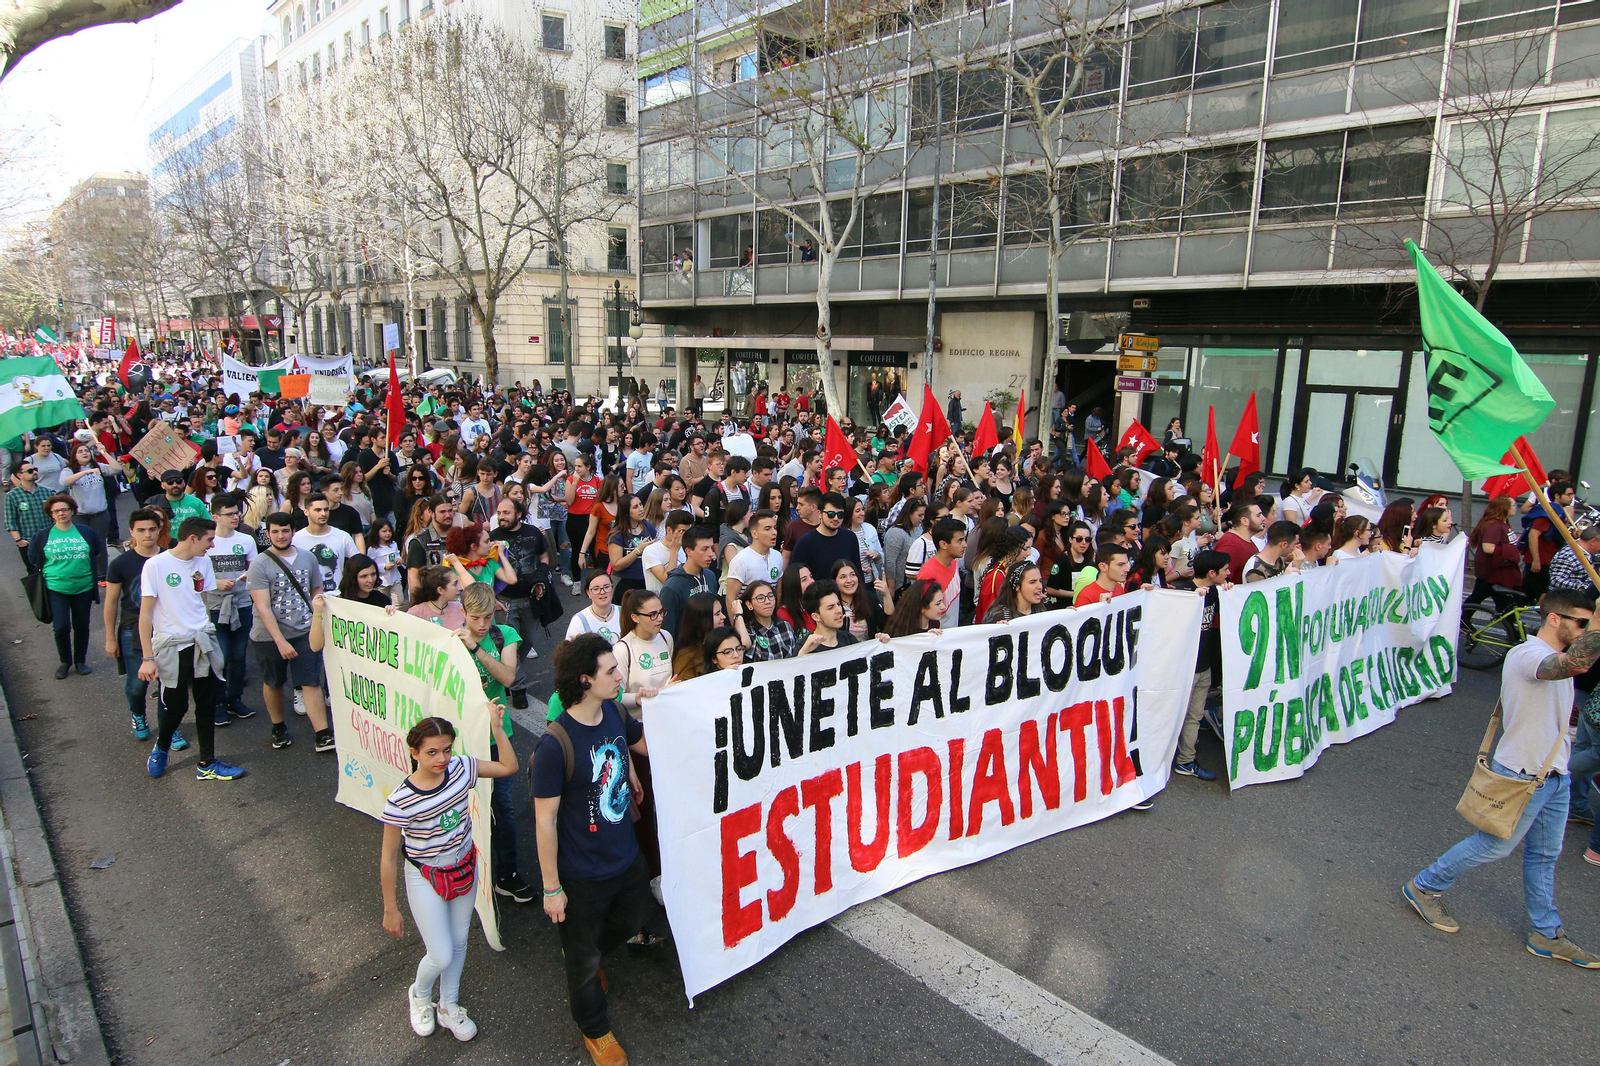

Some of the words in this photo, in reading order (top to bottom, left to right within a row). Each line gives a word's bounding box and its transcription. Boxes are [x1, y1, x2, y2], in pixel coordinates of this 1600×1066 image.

[735, 351, 763, 359] CORTEFIEL
[860, 355, 896, 363] CORTEFIEL
[989, 349, 1020, 357] REGINA
[226, 369, 258, 382] VALIEN
[1008, 373, 1027, 388] 27
[703, 505, 710, 518] 3
[331, 614, 399, 669] APRENDE
[340, 666, 386, 720] LUCHA
[1339, 658, 1369, 728] DE
[713, 650, 896, 814] ¡ÚNETE
[907, 649, 971, 729] AL
[985, 605, 1142, 706] BLOQUE
[443, 816, 457, 827] 5%
[720, 686, 1144, 951] ESTUDIANTIL!
